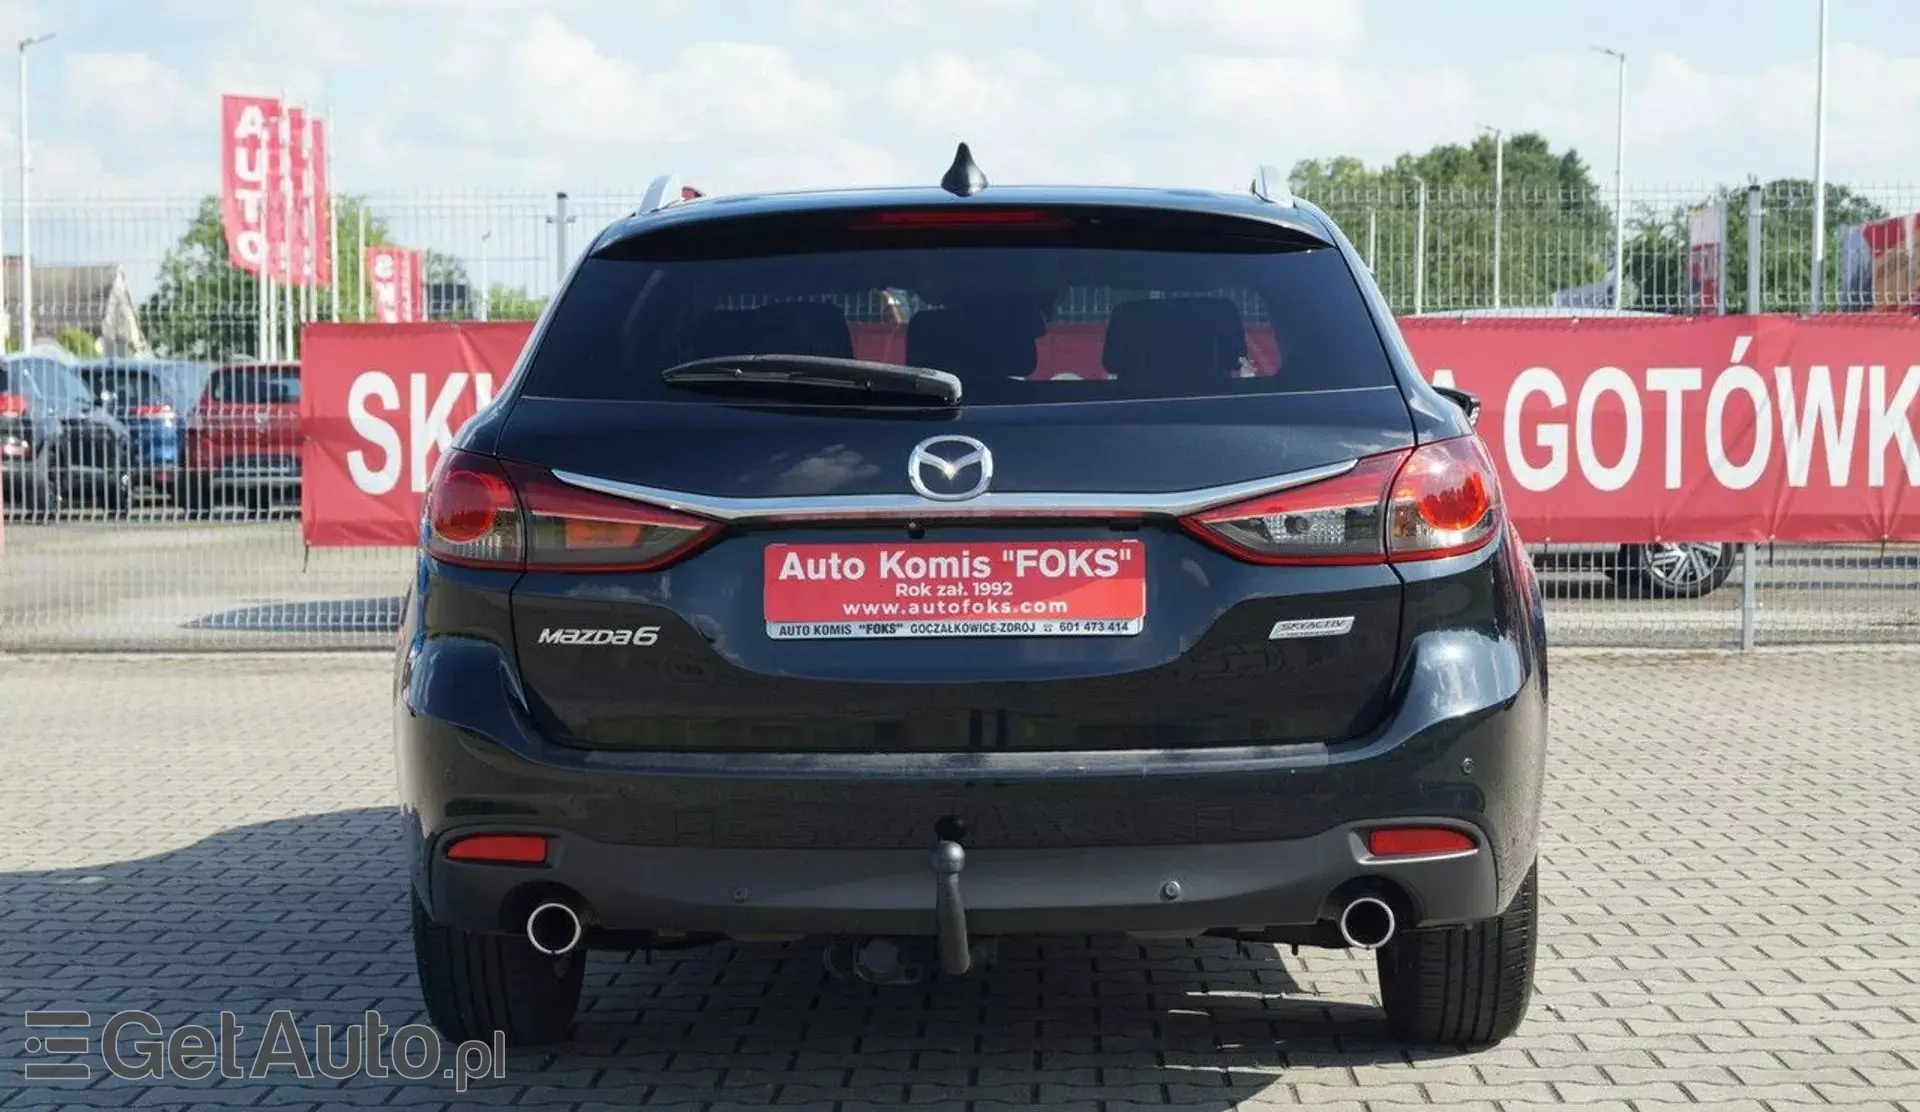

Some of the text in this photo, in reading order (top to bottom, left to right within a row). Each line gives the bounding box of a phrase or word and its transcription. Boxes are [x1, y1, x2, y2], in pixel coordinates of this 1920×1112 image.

[234, 105, 267, 264] AUTO
[779, 548, 1132, 580] Auto Komis "FOKS"
[895, 582, 1013, 597] Rok zał. 1992
[843, 599, 1068, 614] www.autofoks.com
[779, 625, 809, 635] AUTO
[813, 624, 851, 635] KOMIS
[859, 623, 903, 634] "FOKS"
[1059, 621, 1079, 632] 601
[1083, 621, 1104, 632] 473
[1107, 621, 1129, 632] 414
